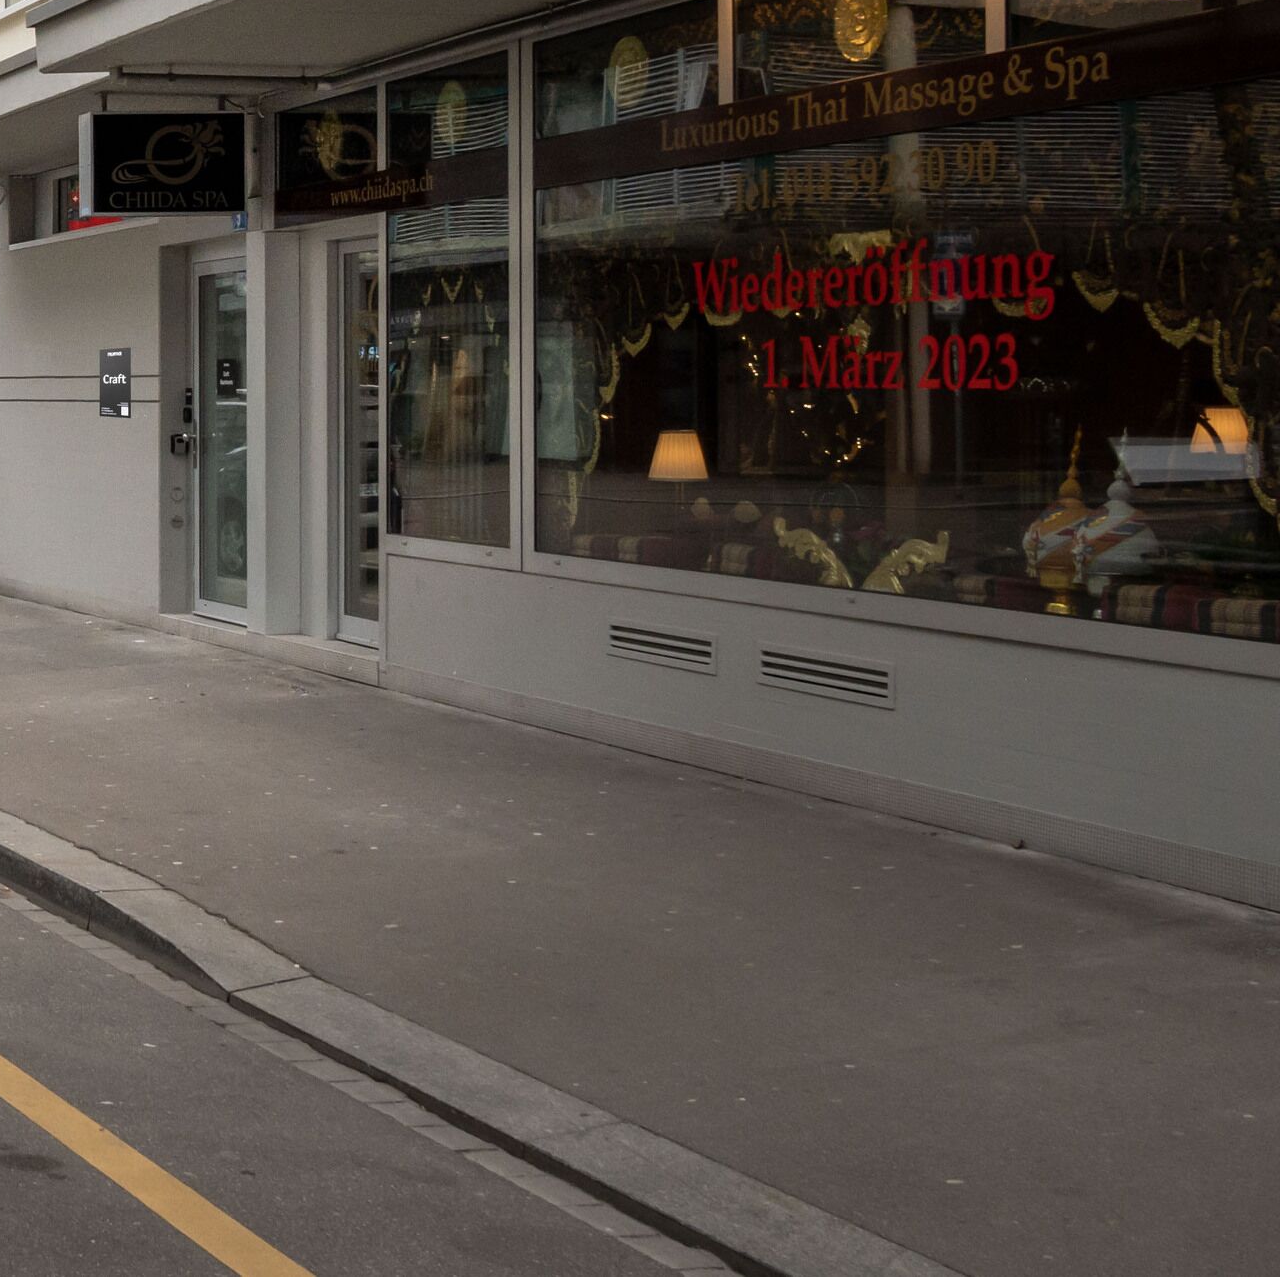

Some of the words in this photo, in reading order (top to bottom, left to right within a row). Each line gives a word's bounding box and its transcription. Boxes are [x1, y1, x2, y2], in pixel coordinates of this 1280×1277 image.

[660, 108, 780, 153] Luxurious
[786, 85, 849, 133] Thai
[863, 69, 994, 118] Massage
[1003, 53, 1033, 97] &
[1044, 46, 1110, 101] Spa
[956, 139, 998, 186] 90
[109, 191, 188, 209] CHIIDA
[192, 190, 229, 208] SPA
[330, 169, 434, 207] www.chiidaspa.ch
[692, 237, 1055, 322] Wiedereröffnung
[102, 373, 127, 384] Craft
[760, 338, 789, 390] 1.
[800, 334, 904, 391] März
[917, 332, 1019, 391] 2023
